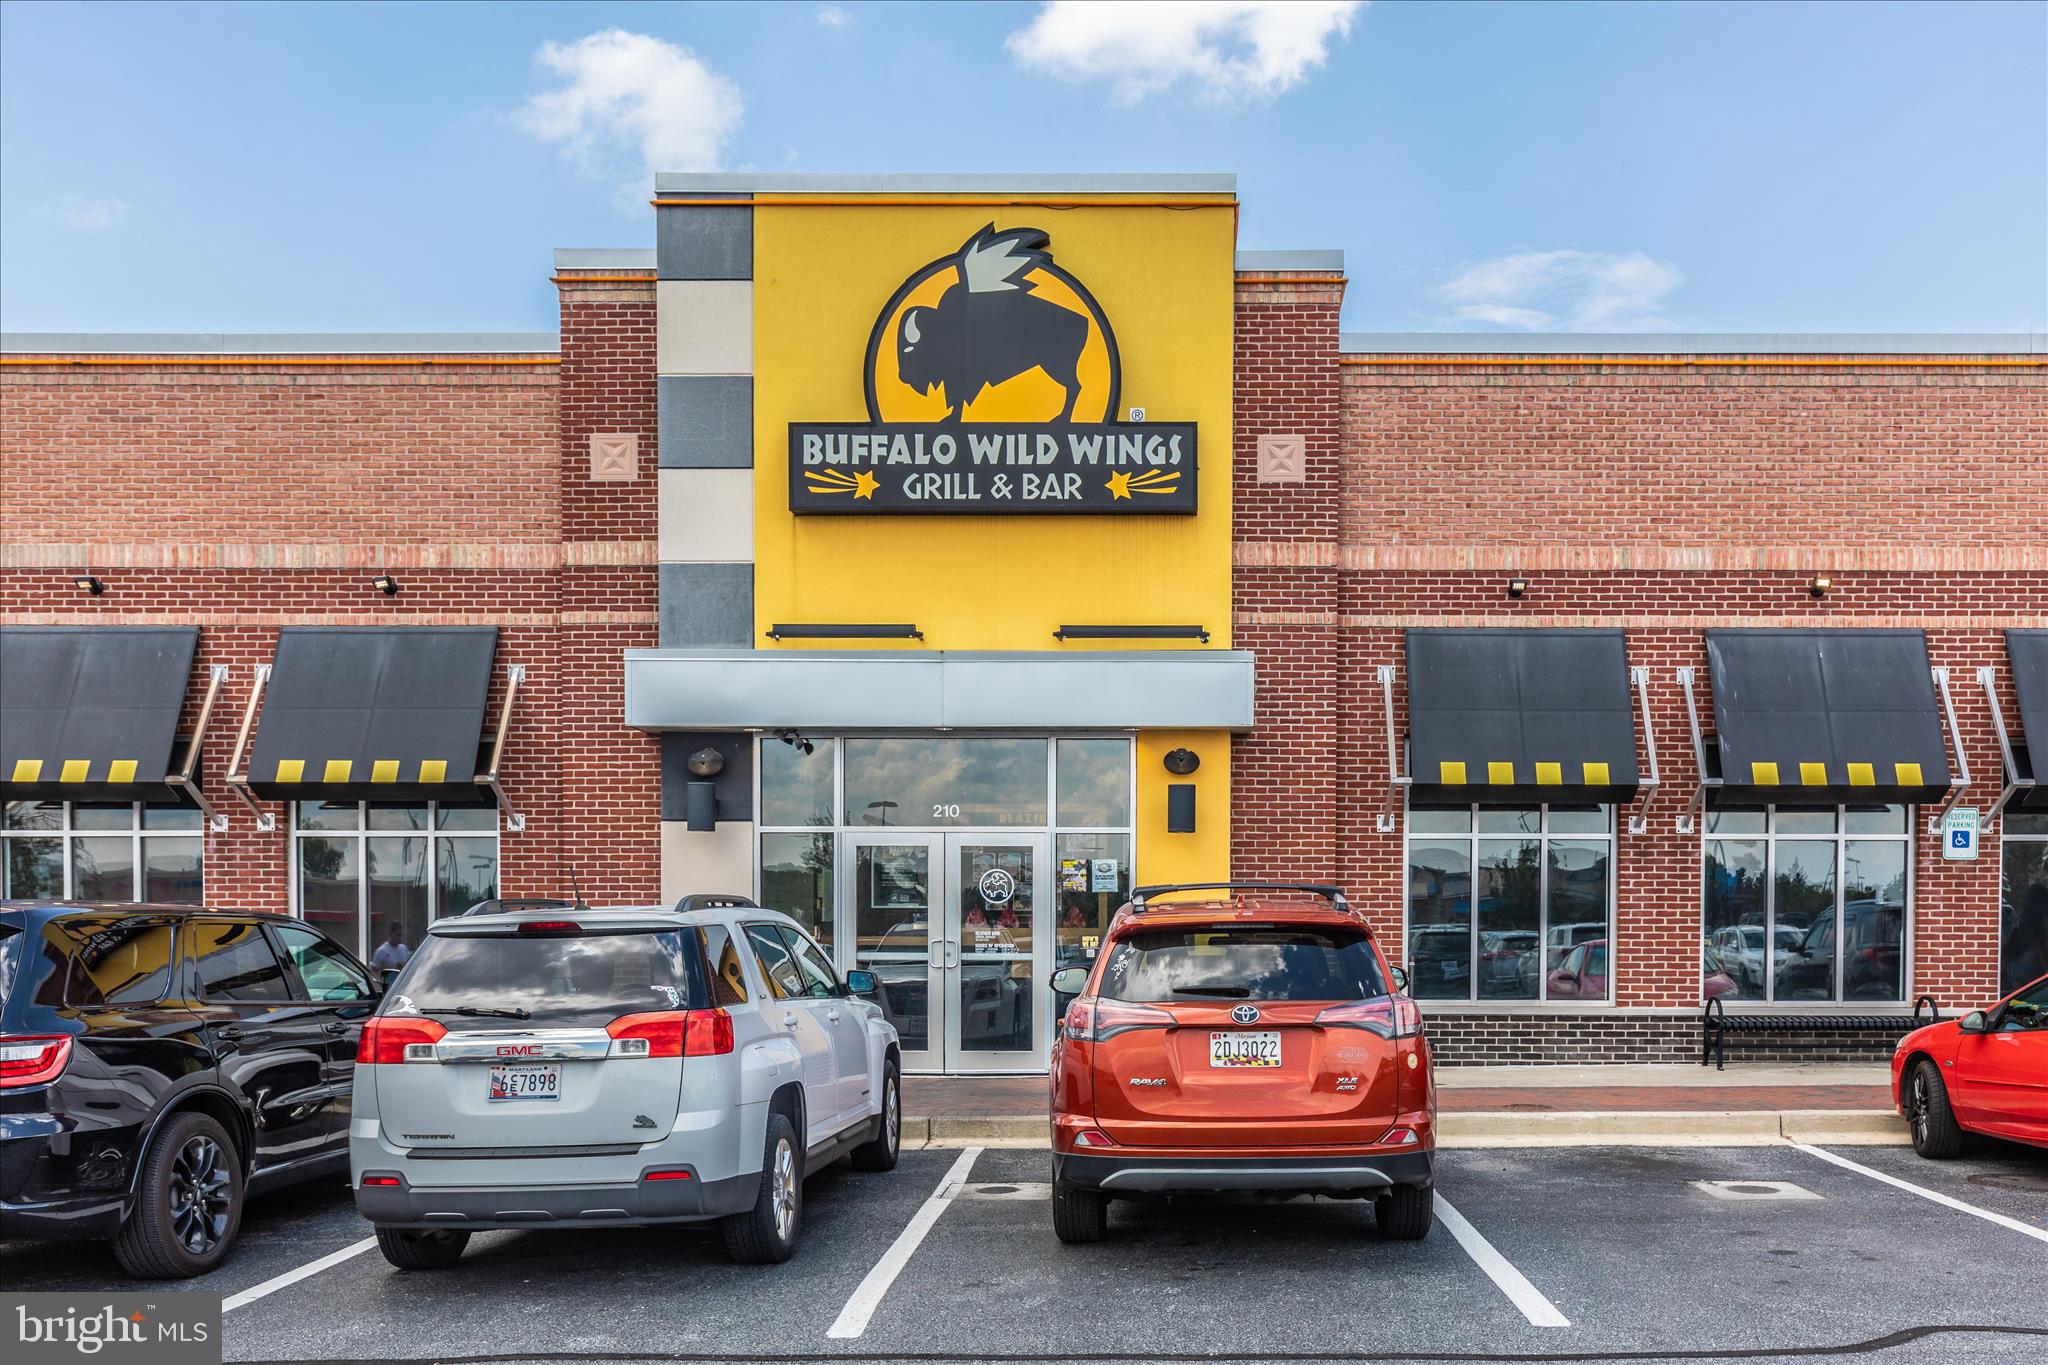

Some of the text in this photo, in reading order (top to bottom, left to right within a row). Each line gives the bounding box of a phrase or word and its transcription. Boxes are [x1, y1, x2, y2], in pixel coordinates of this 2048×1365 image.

[803, 434, 1183, 465] BUFFALO WILD WINGS
[903, 473, 1083, 499] GRILL & BAR
[932, 804, 960, 818] 210
[1947, 821, 1975, 829] PARKING
[496, 1046, 544, 1057] GMC
[1214, 1041, 1277, 1058] 2DJ3022
[1128, 1078, 1167, 1086] RAV4
[1335, 1077, 1358, 1085] XLE
